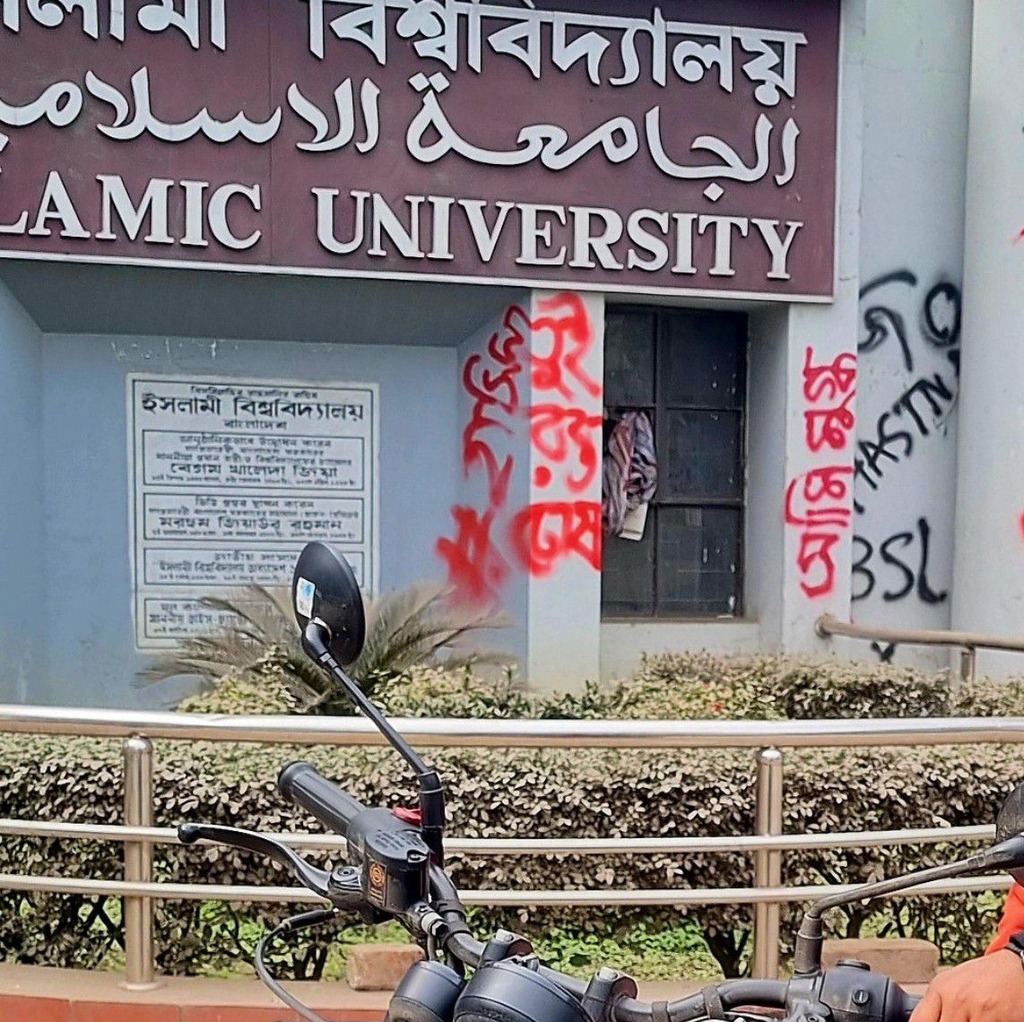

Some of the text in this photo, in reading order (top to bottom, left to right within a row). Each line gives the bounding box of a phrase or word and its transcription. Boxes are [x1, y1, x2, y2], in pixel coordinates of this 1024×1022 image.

[407, 72, 800, 202] الجامعة
[311, 187, 803, 281] UNIVERSITY
[142, 393, 364, 422] ইসলামী বিশ্ববিদ্যালয়
